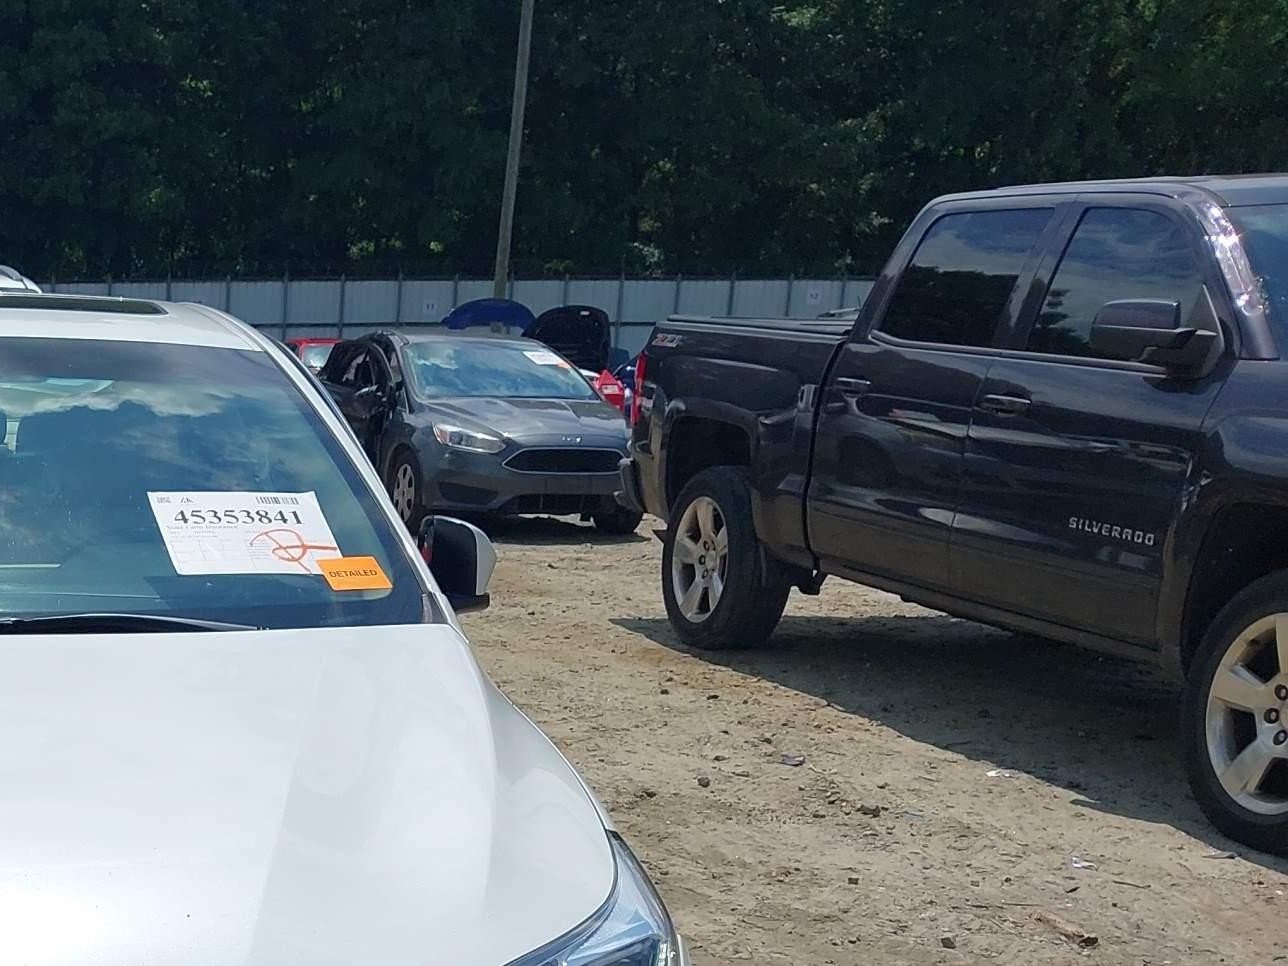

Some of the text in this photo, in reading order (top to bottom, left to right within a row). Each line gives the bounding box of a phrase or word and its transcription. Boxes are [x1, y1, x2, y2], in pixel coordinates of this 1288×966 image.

[174, 509, 303, 525] 45353841
[1068, 516, 1155, 546] SILVERADO
[328, 569, 378, 578] DETAILED
